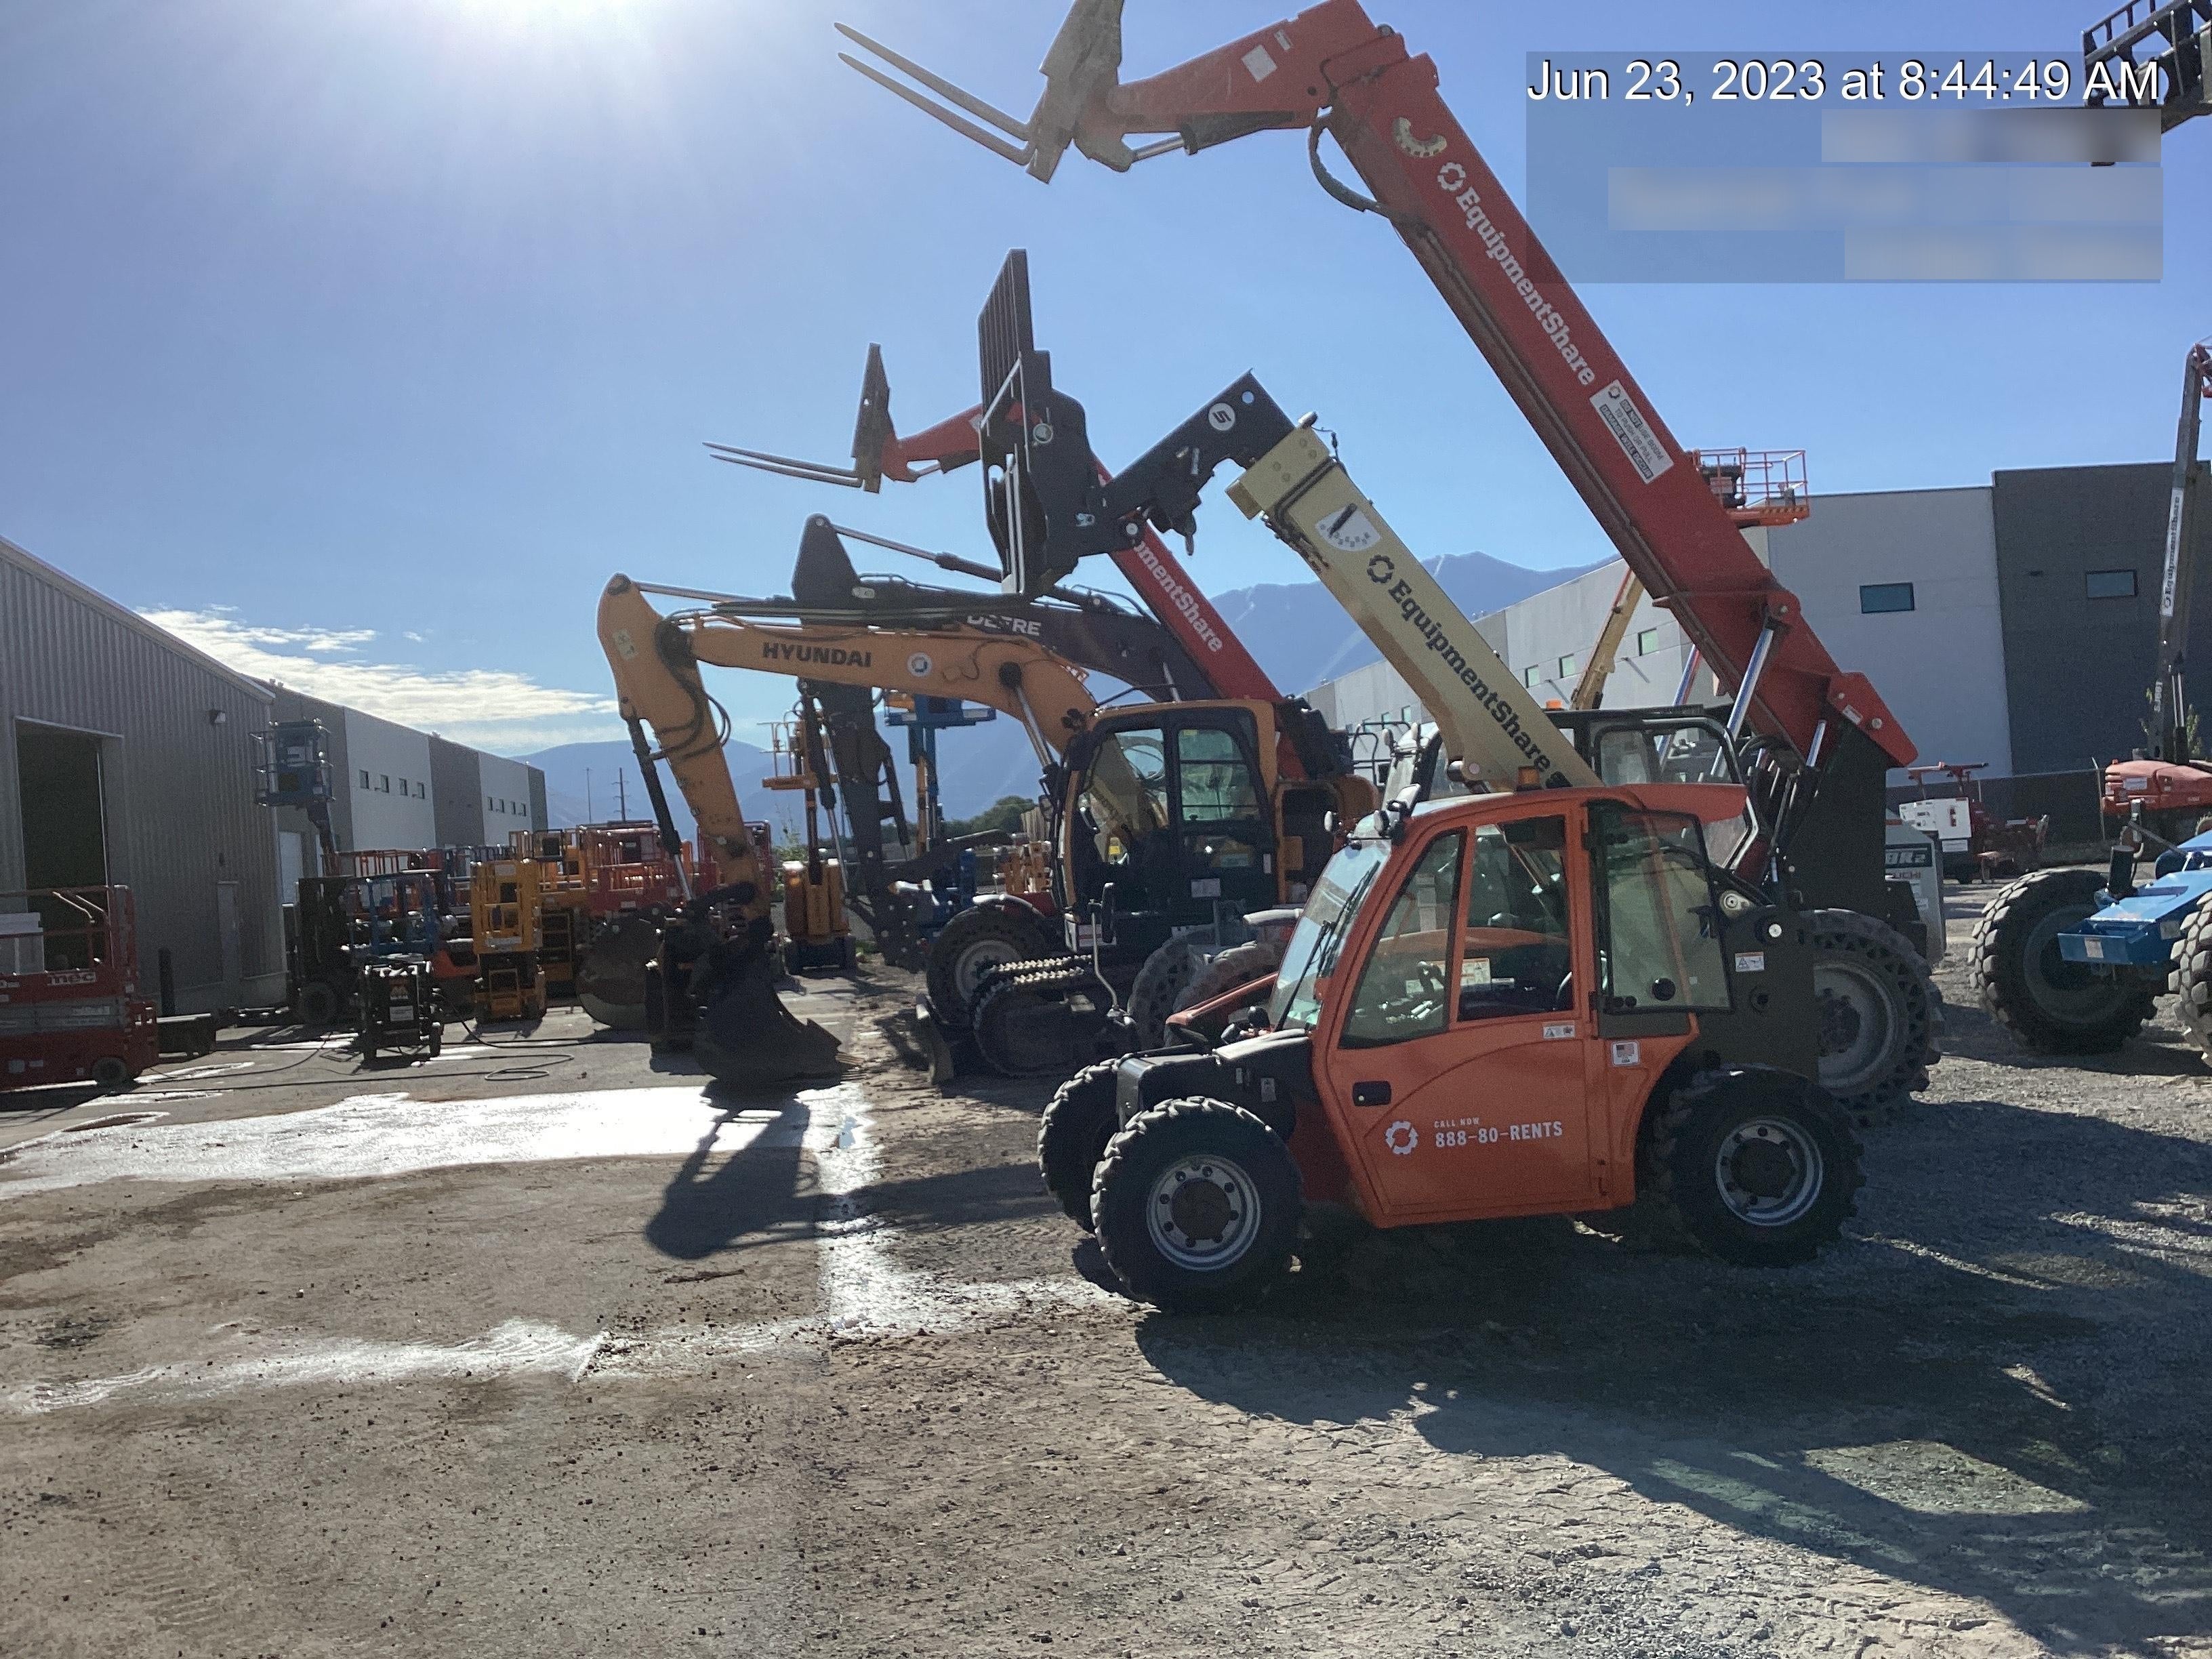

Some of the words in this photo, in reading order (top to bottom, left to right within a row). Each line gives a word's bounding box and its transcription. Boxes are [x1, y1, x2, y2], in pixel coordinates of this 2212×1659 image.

[1456, 186, 1595, 385] EquipmentShare
[1628, 411, 1641, 427] NOT
[763, 642, 872, 668] HYUNDAI
[1389, 578, 1551, 773] EquipmentShare
[1434, 1120, 1456, 1128] CALL
[1460, 1117, 1479, 1126] NOW
[1435, 1121, 1563, 1148] 888-80-RENTS
